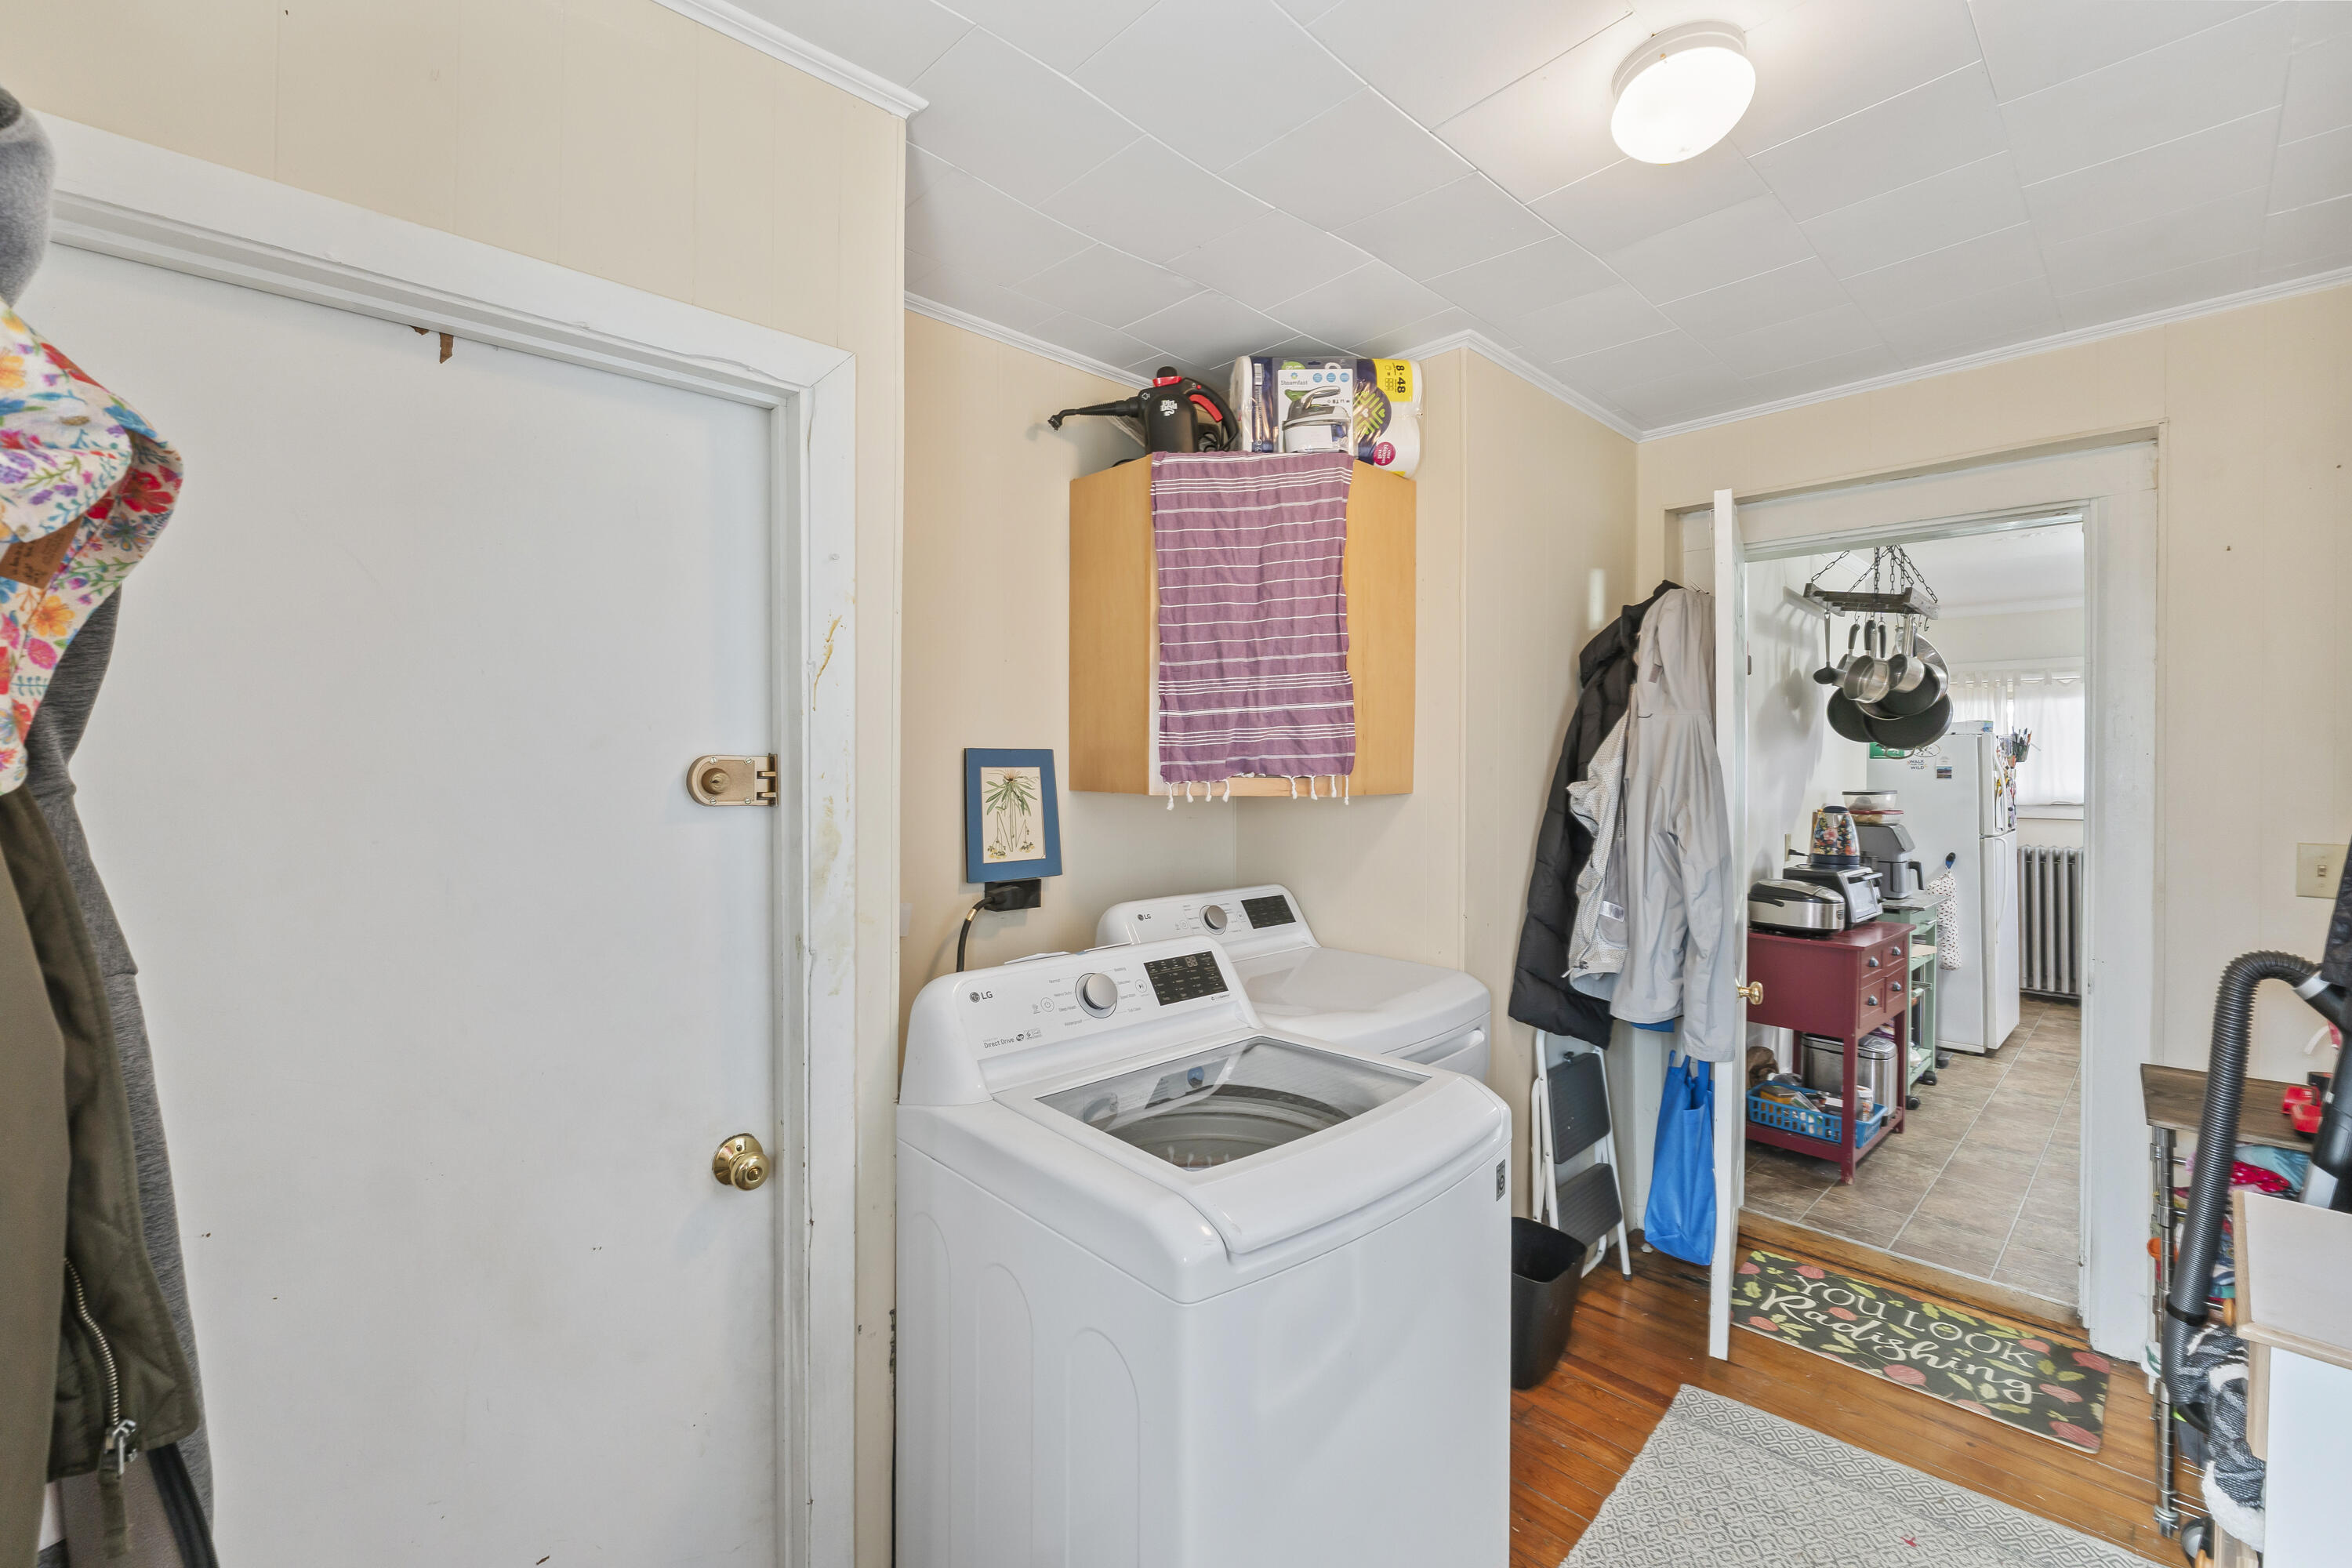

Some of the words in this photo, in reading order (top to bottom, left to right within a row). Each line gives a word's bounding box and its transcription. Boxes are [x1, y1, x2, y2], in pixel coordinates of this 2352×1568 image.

[1397, 377, 1406, 394] 48
[981, 990, 993, 1000] LG
[984, 1040, 1001, 1049] Direct
[1794, 1274, 1889, 1319] YOU
[1904, 1310, 2036, 1368] LOOK
[1759, 1288, 2045, 1405] Radishing
